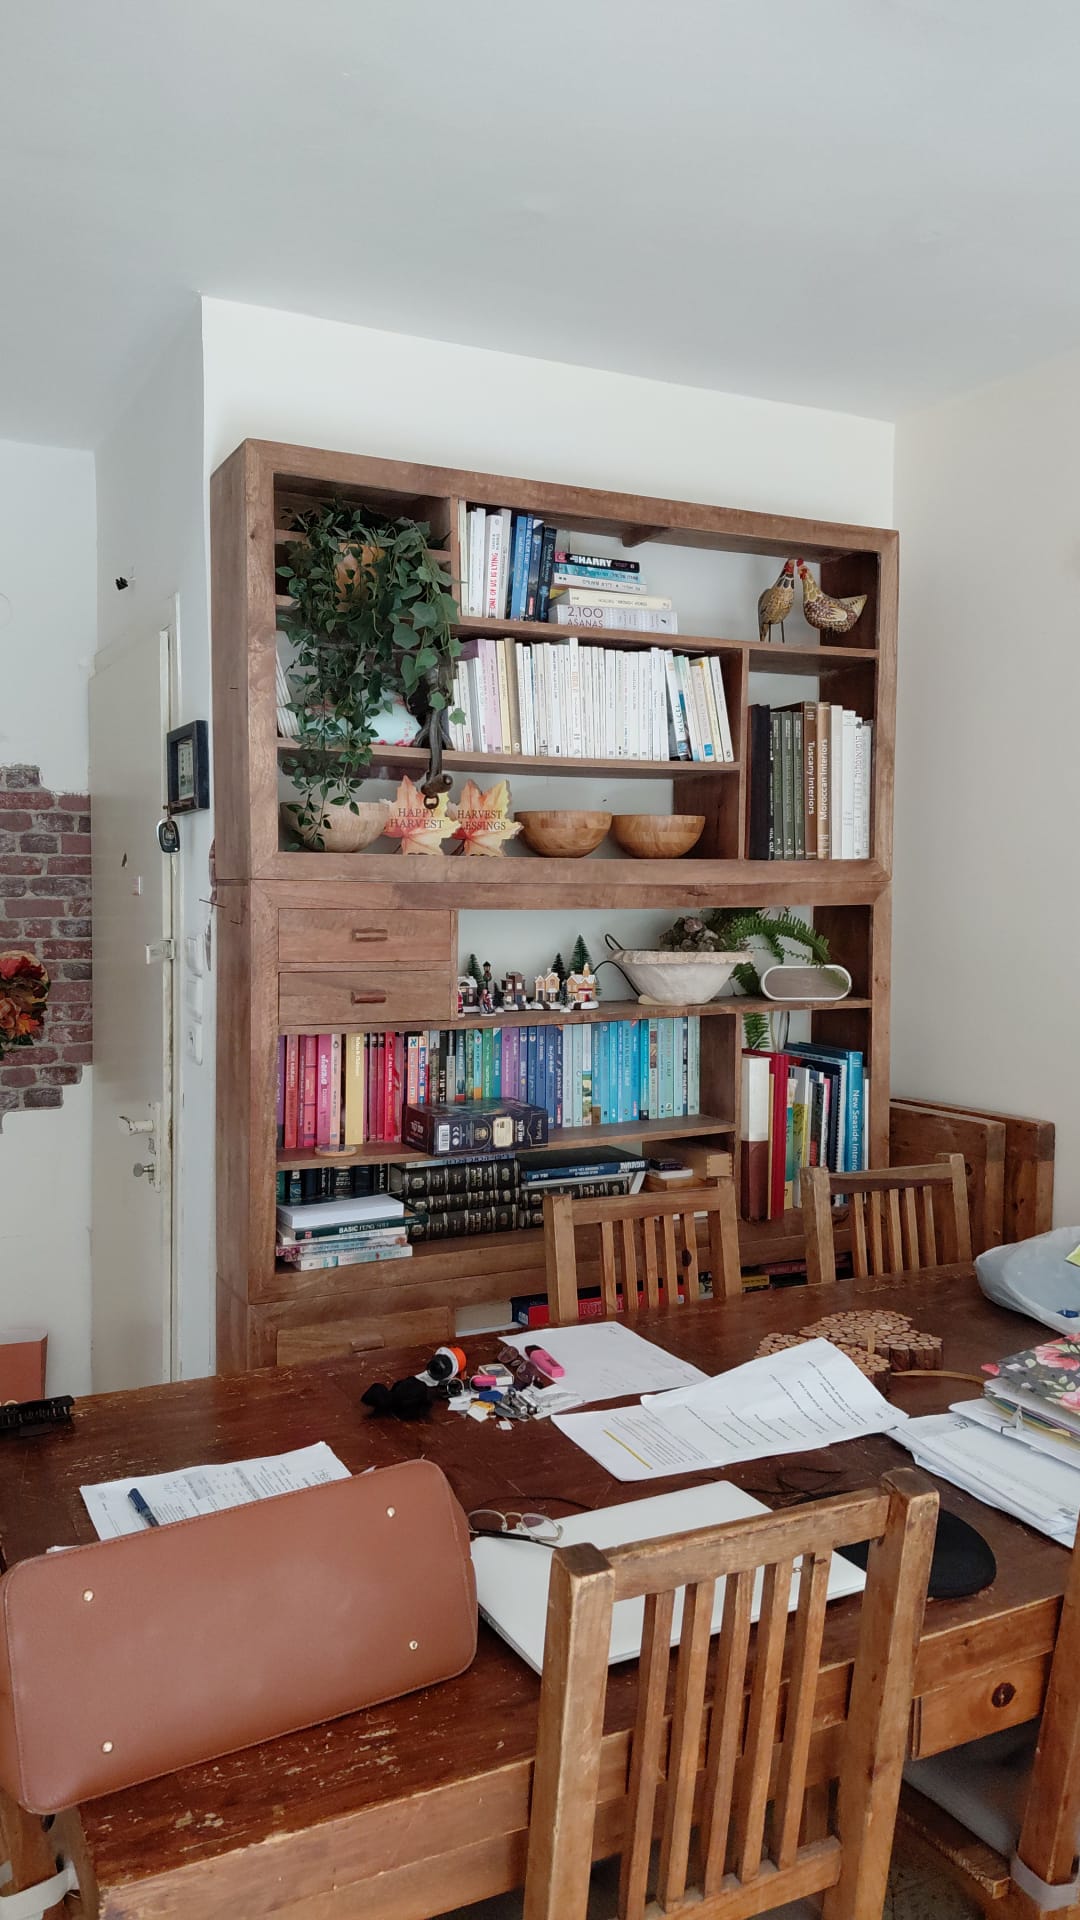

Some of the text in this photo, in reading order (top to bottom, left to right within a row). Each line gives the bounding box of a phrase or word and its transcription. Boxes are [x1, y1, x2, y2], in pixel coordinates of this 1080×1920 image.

[490, 552, 499, 571] LYING
[578, 556, 612, 568] HARRY
[490, 579, 497, 587] US
[490, 588, 497, 596] OF
[489, 597, 497, 609] ONE
[567, 606, 604, 618] 2,100
[567, 618, 604, 628] ASANAS
[807, 742, 817, 815] Tuscany Interiors
[820, 738, 829, 820] Moroccan Interiors
[398, 808, 435, 818] HAPPY
[457, 810, 503, 819] HARVEST
[390, 819, 445, 829] HARVEST
[851, 1089, 860, 1171] New Seaside Interio
[339, 1225, 359, 1234] BASIC
